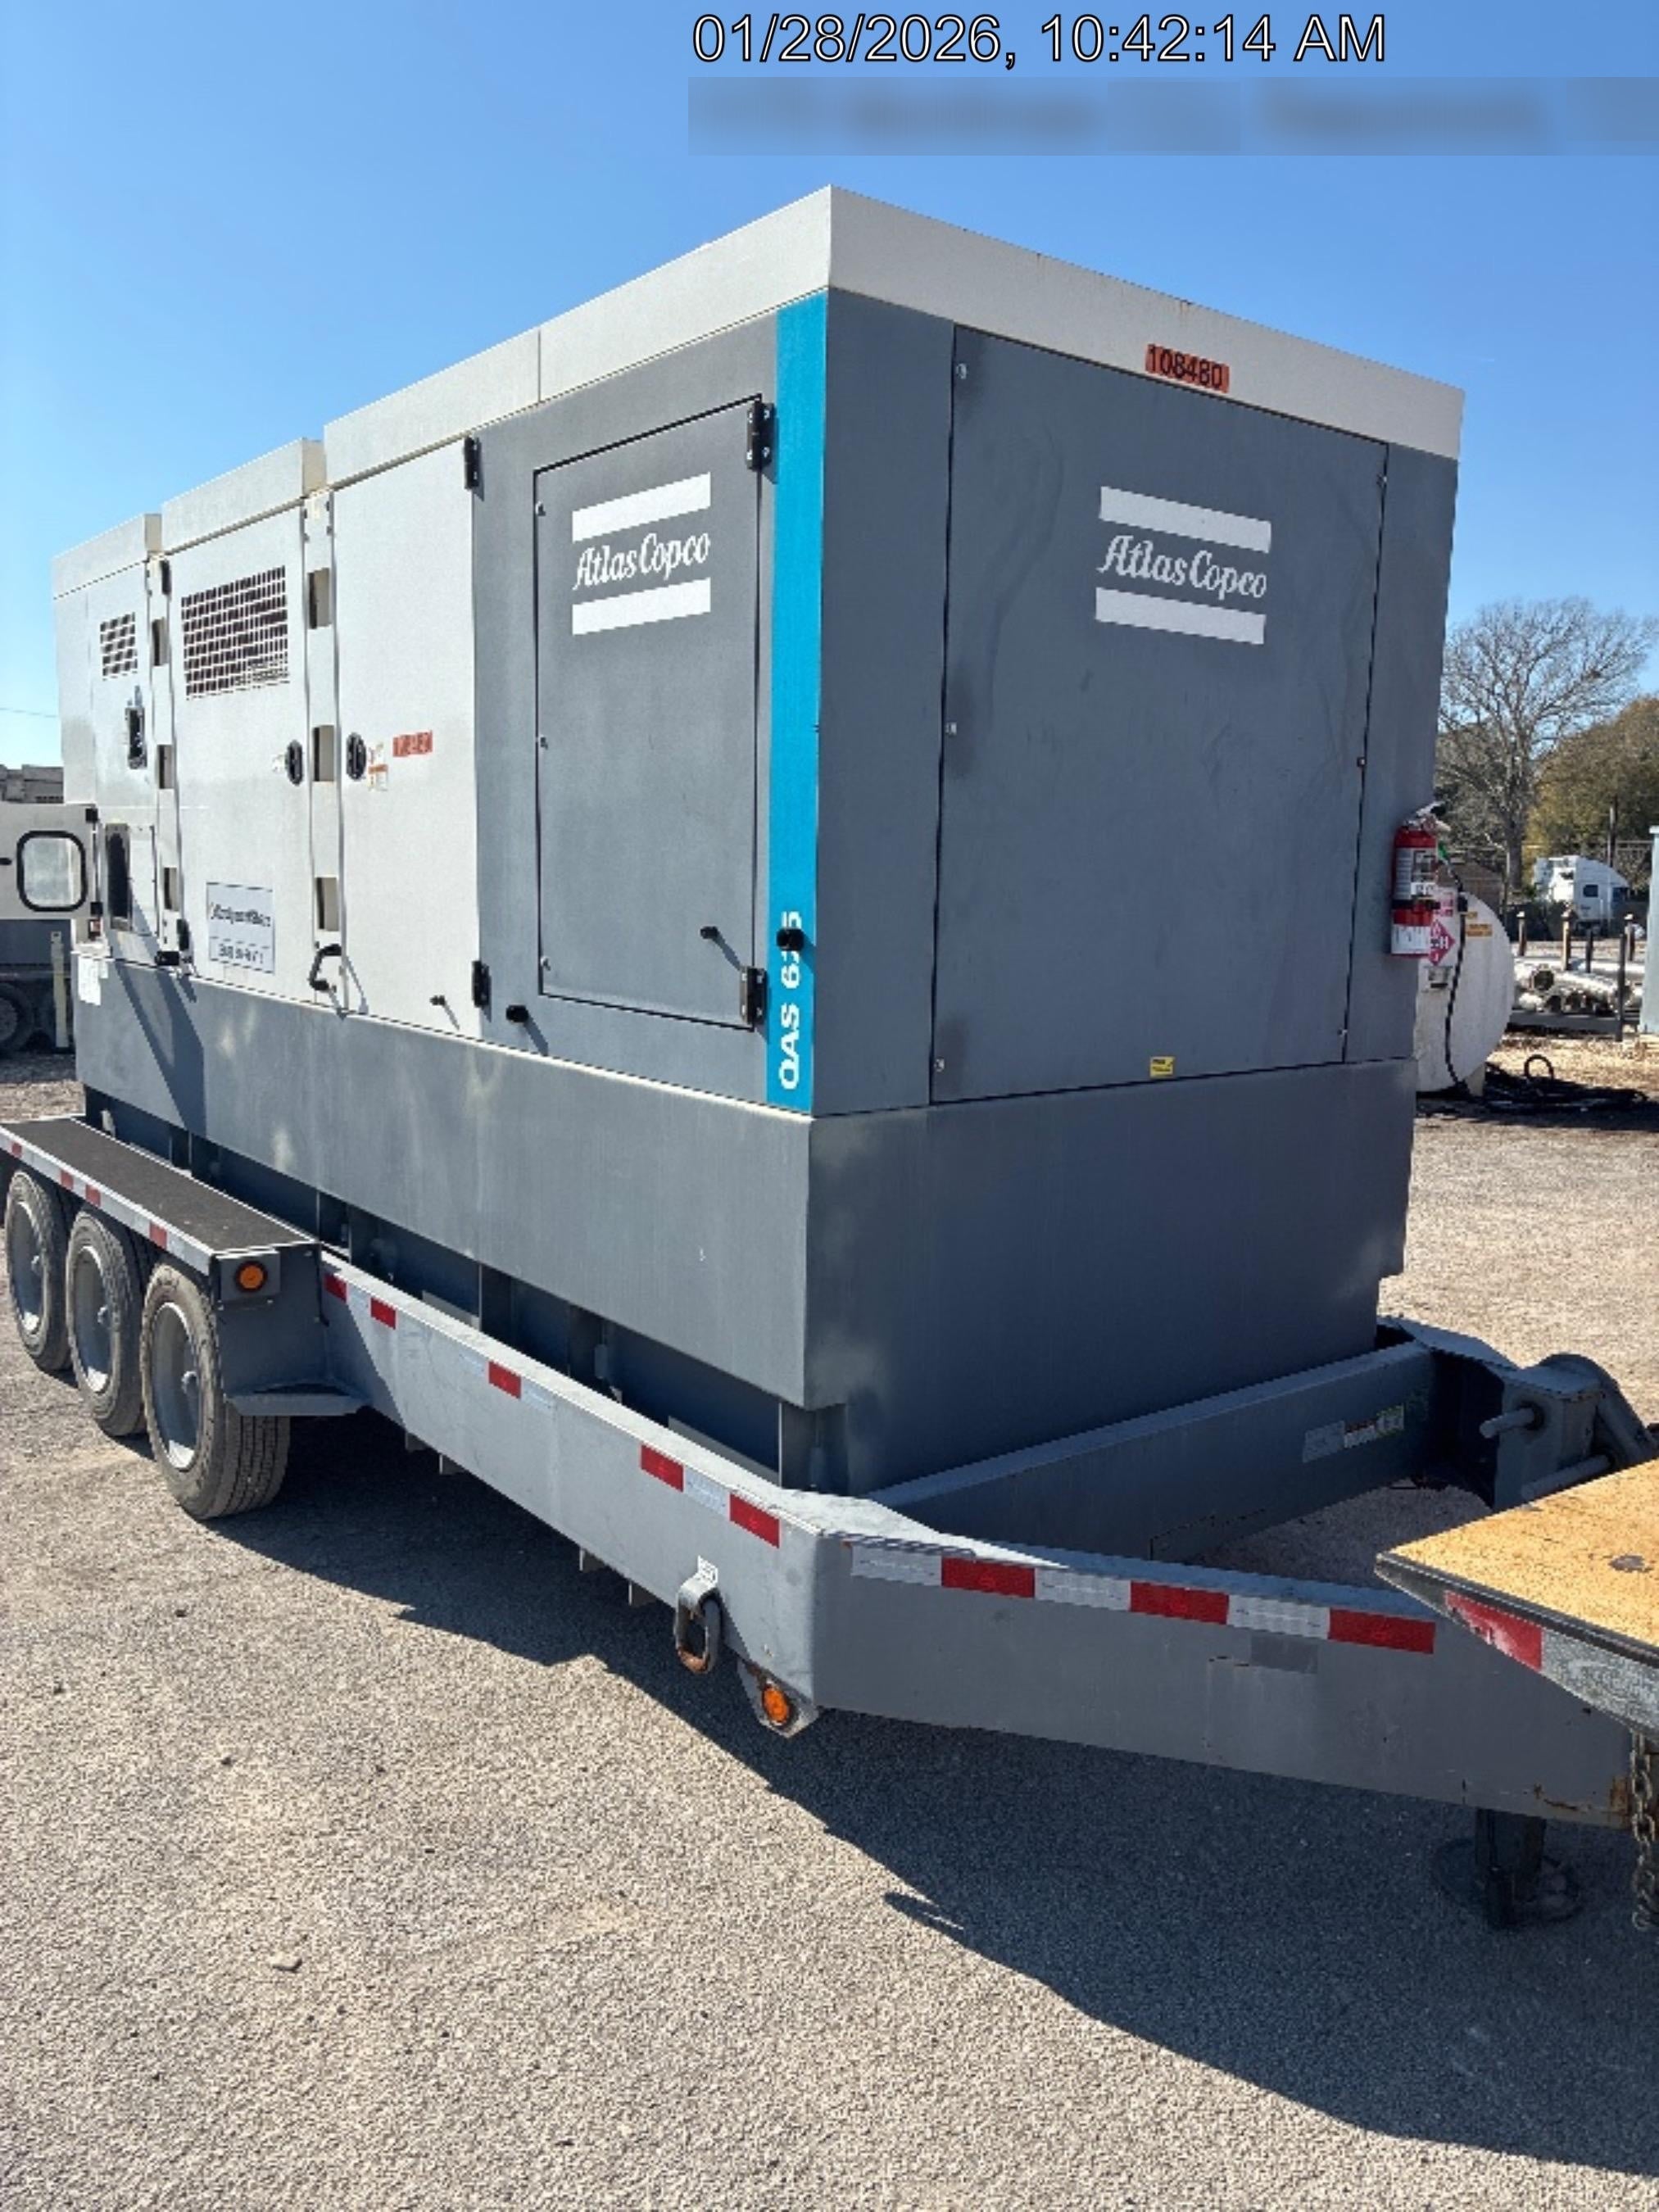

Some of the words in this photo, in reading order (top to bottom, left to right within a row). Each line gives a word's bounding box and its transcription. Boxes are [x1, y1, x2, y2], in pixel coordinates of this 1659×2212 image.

[1148, 343, 1222, 389] 108480
[572, 543, 637, 591] Atlas
[639, 533, 711, 581] Copco
[1095, 535, 1187, 586] Atlas
[1190, 550, 1267, 600] Copco
